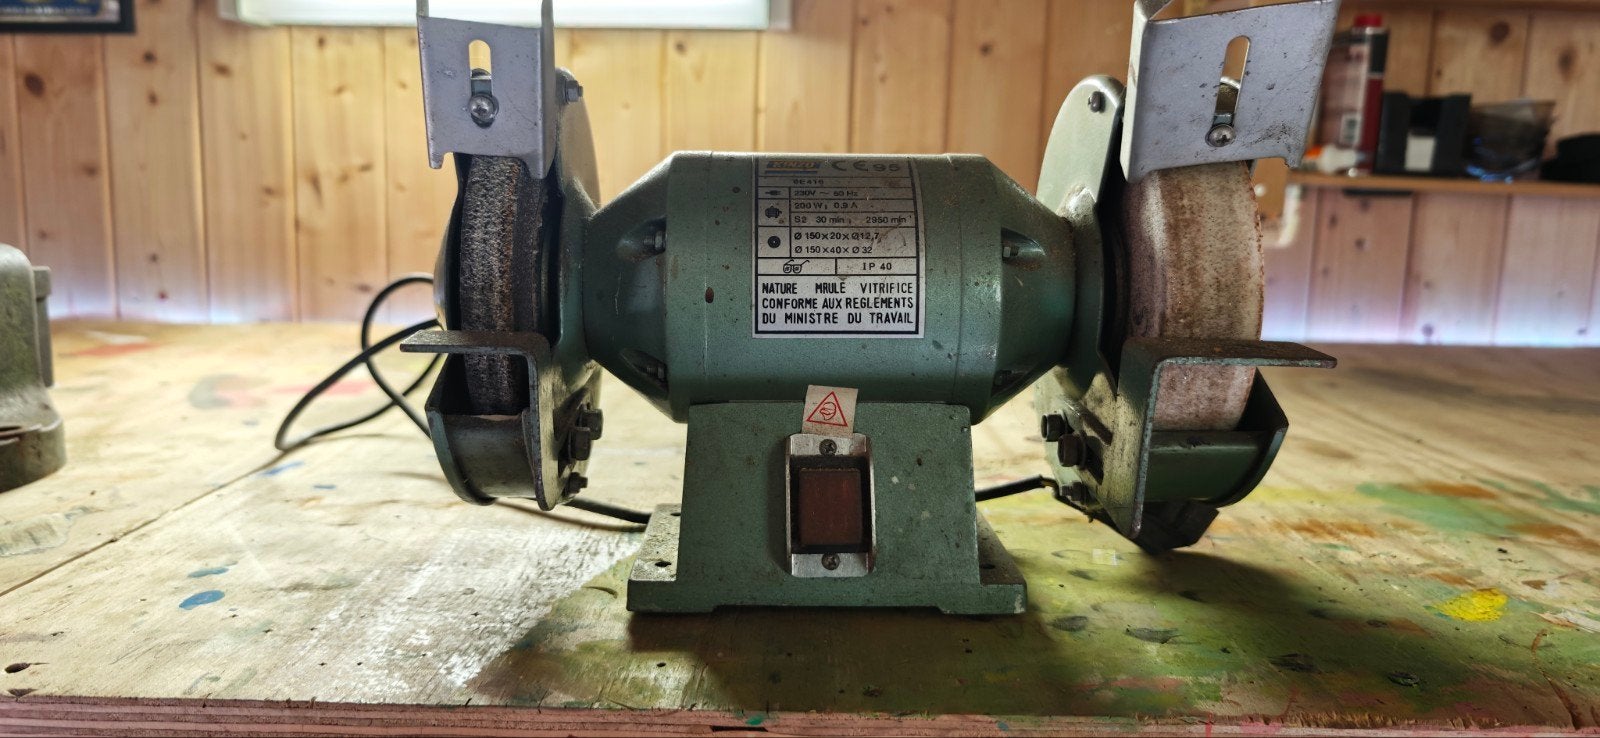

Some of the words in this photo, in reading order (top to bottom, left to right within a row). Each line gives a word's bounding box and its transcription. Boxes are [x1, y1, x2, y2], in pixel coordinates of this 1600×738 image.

[866, 215, 889, 223] 2950
[880, 262, 892, 271] 40
[762, 282, 798, 295] NATURE
[762, 298, 818, 309] CONFORME
[821, 298, 843, 309] AUX
[845, 297, 914, 309] REGLEMENTS
[762, 312, 776, 324] DU
[784, 312, 838, 324] MINISTRE
[847, 312, 862, 324] DU
[869, 312, 914, 324] TRAVAIL
